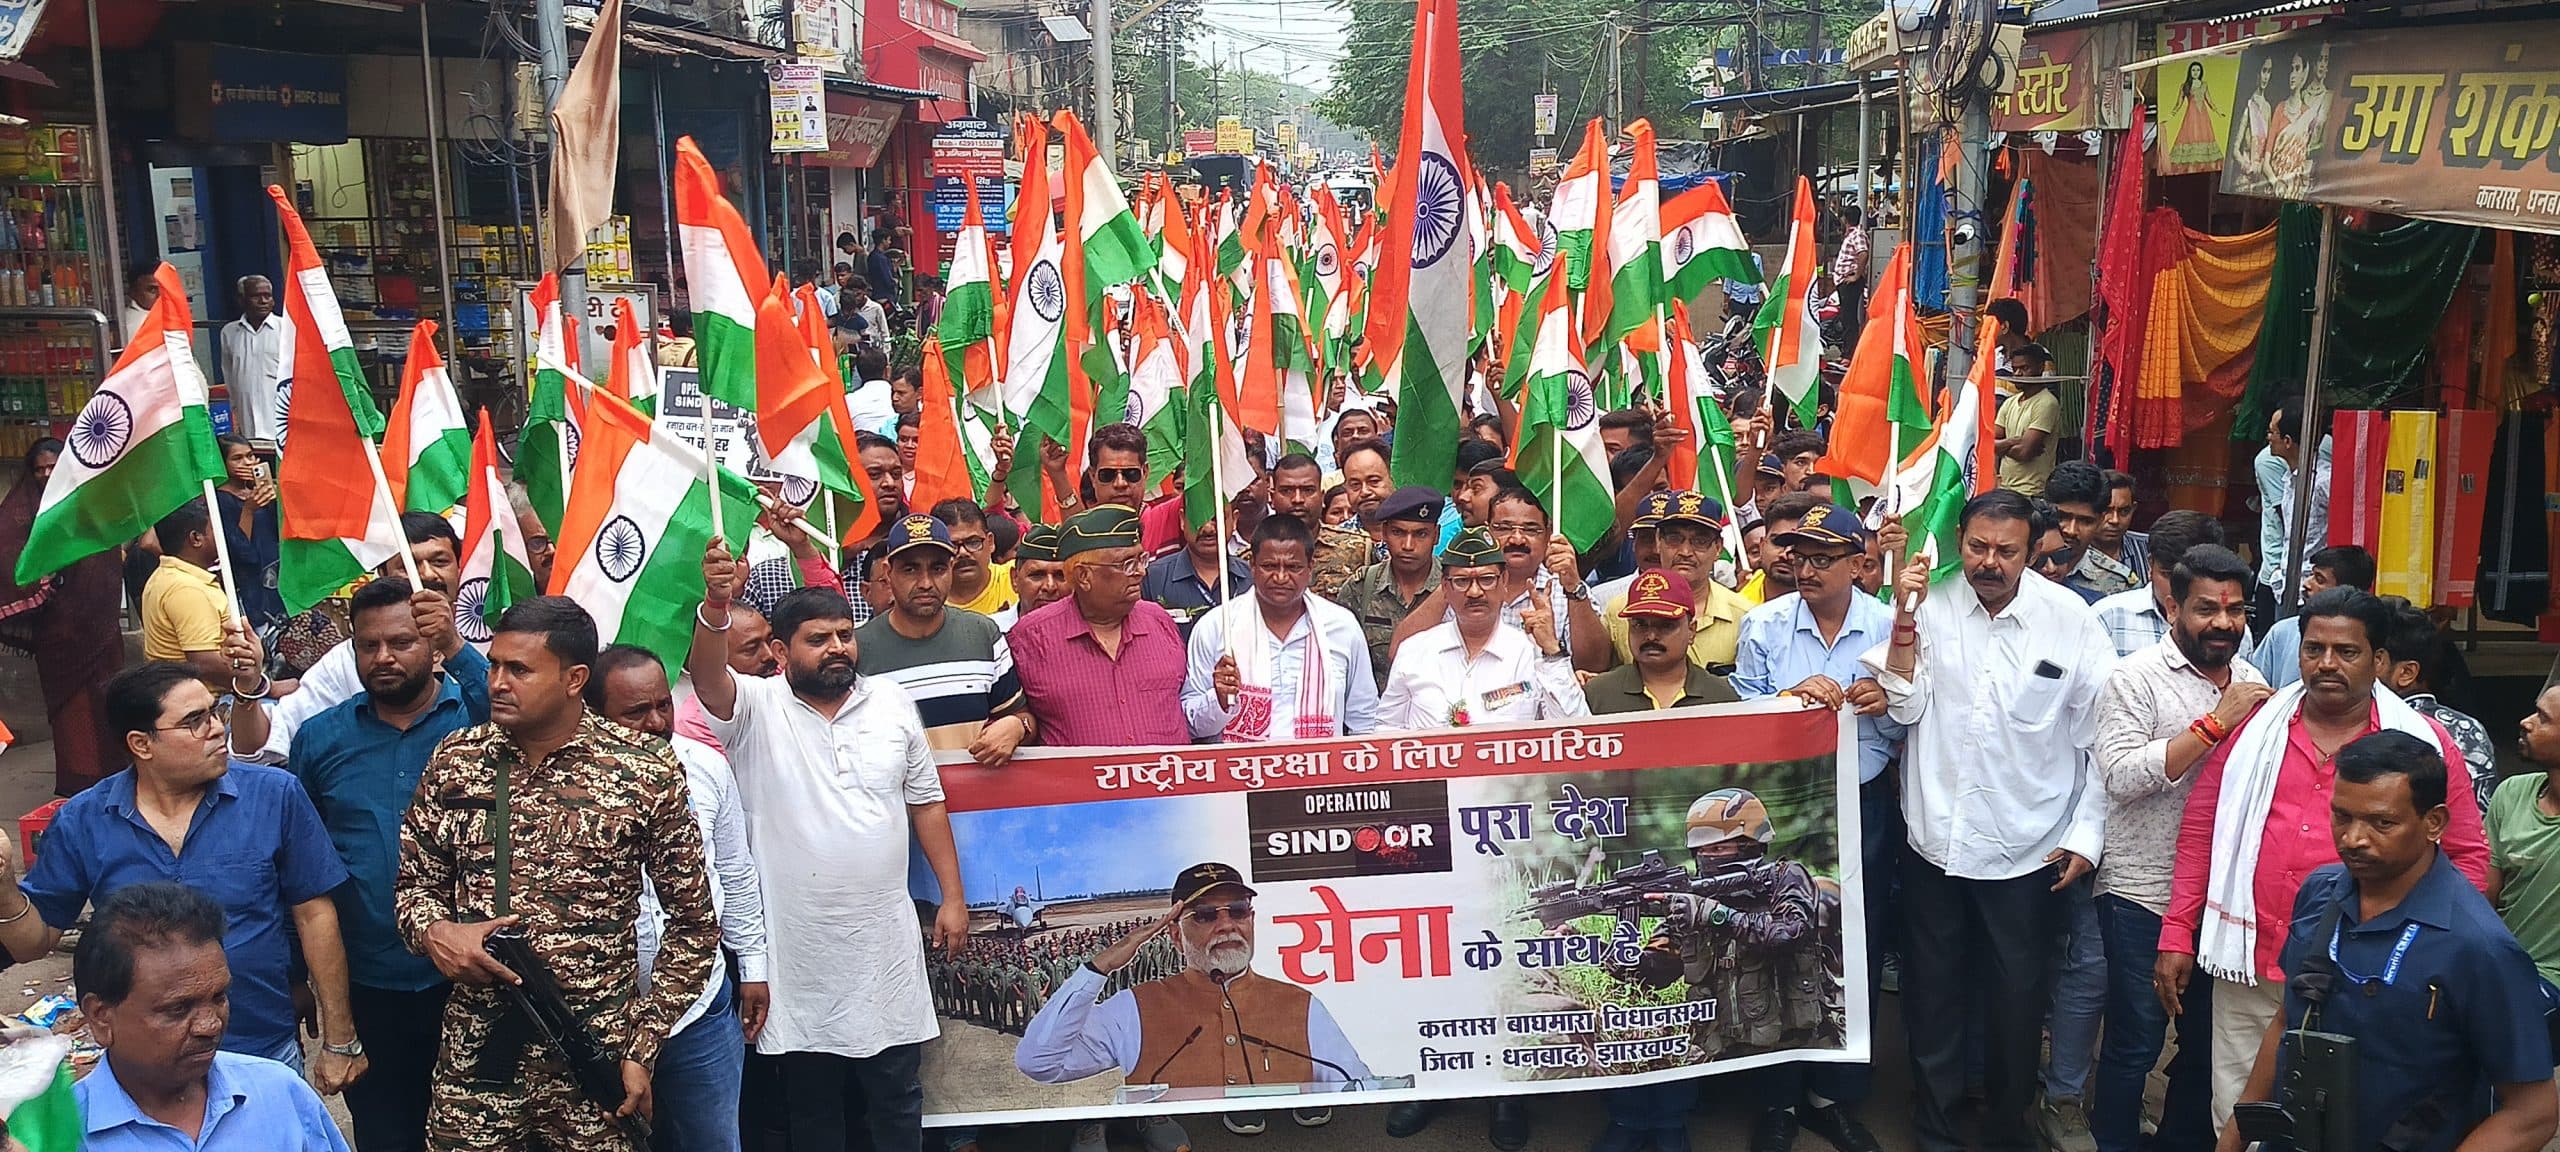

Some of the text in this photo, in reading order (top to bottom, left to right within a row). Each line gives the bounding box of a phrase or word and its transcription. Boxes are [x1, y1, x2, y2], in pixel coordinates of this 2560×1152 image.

[2018, 51, 2072, 115] स्टोर
[2342, 44, 2560, 159] उमा शंक
[945, 120, 987, 130] अग्रवाल
[2476, 185, 2560, 216] कतरास, धनबा
[674, 395, 729, 410] SINDOR
[1094, 728, 1624, 792] राष्ट्रीय सुरक्षा के लिए नागरिक
[1305, 790, 1391, 814] OPERATION
[1459, 784, 1630, 855] पूरा देश
[1272, 885, 1453, 984] सेना
[1462, 921, 1643, 971] के साथ है
[1418, 999, 1718, 1039] कतरास बाघमारा विधानसभा
[1419, 1046, 1475, 1072] जिला
[1502, 1044, 1588, 1069] धनबाद,
[1595, 1034, 1690, 1064] झारखण्ड
